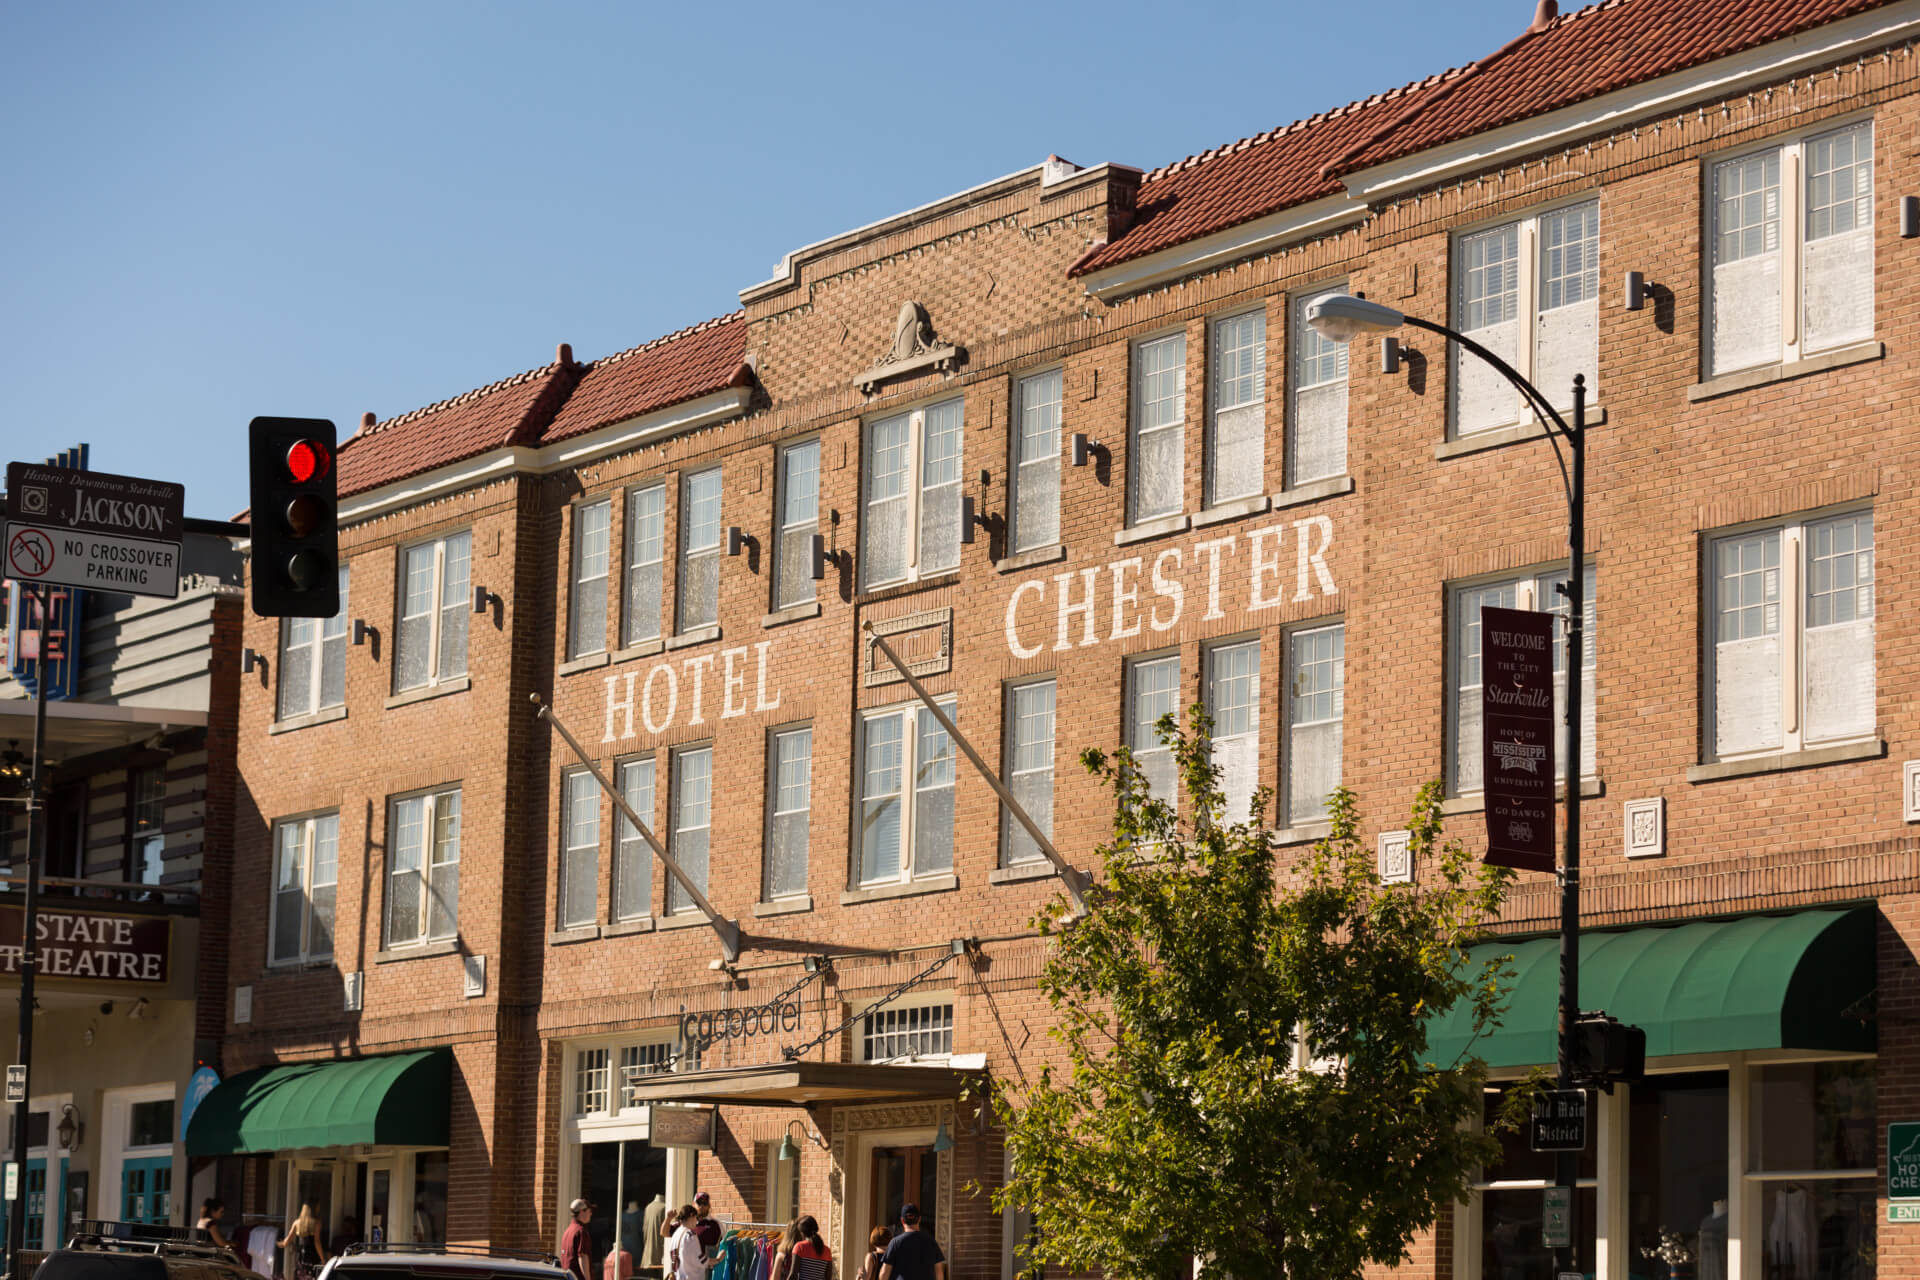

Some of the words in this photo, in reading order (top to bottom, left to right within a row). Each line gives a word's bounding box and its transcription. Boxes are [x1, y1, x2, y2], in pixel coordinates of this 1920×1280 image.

[69, 489, 165, 533] JACKSON
[64, 540, 84, 557] NO
[91, 543, 173, 568] CROSSOVER
[87, 563, 148, 585] PARKING
[1004, 514, 1340, 660] CHESTER
[1490, 631, 1546, 651] WELCOME
[1497, 662, 1517, 672] THE
[1519, 663, 1540, 673] CITY
[1512, 652, 1526, 662] TO
[601, 640, 782, 744] HOTEL
[1486, 683, 1551, 709] Starkville
[1492, 742, 1547, 760] MISSISSIPPI
[1494, 776, 1545, 789] UNIVERSITY
[1495, 807, 1509, 816] GO
[1511, 808, 1546, 819] DAWGS
[35, 913, 134, 945] STATE
[0, 945, 161, 980] THEATRE
[1539, 1124, 1579, 1142] District
[1890, 1176, 1920, 1189] CHE
